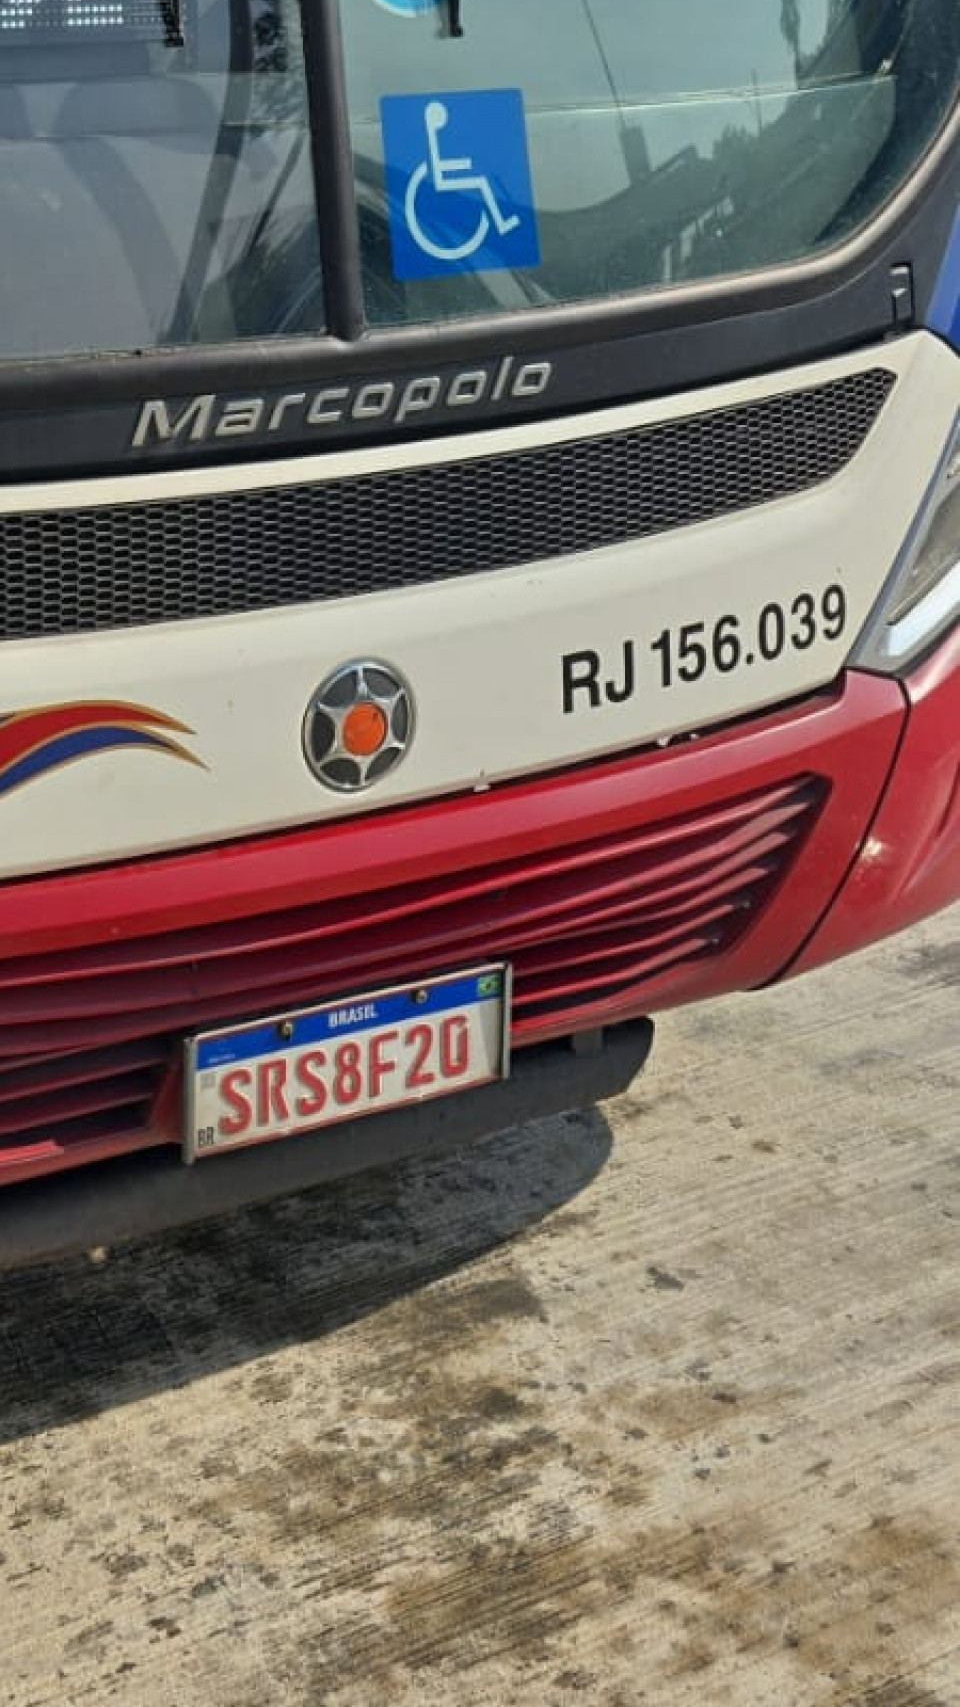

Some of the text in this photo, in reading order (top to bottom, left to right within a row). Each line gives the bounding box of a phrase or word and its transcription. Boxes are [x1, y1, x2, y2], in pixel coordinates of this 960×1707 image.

[131, 355, 553, 448] Marcopolo
[561, 583, 847, 714] RJ 156.039
[327, 1003, 379, 1029] BRASIL
[218, 1013, 471, 1136] SRS8F20
